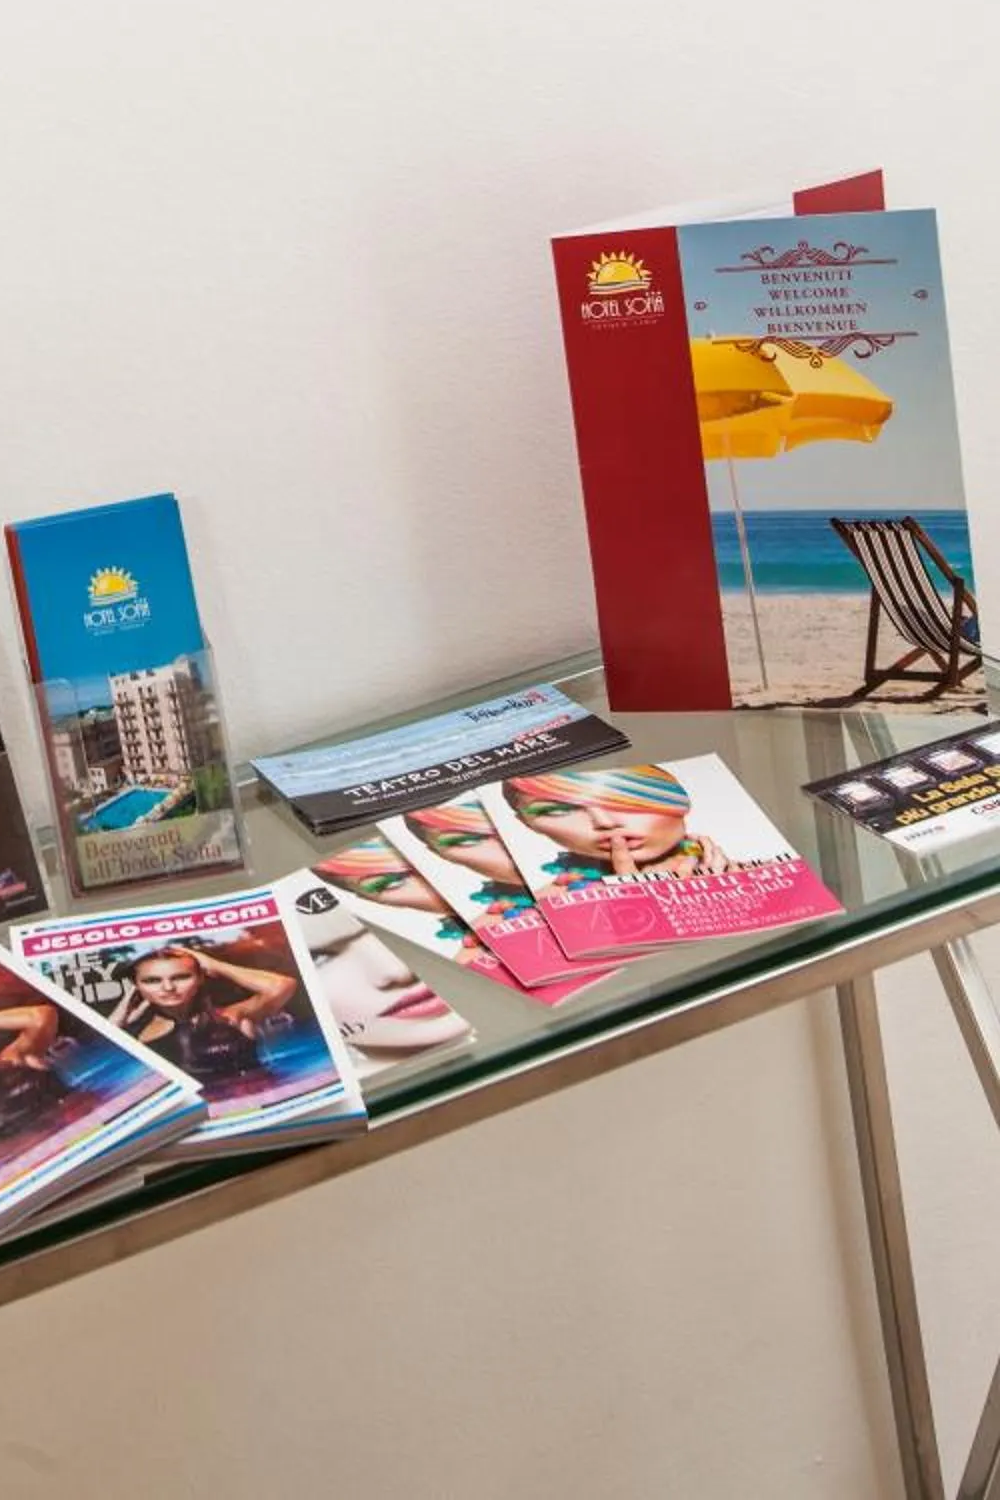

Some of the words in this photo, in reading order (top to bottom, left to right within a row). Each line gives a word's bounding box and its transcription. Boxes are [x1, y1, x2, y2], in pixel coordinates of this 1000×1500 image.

[760, 270, 852, 285] BENVENUTI
[768, 287, 850, 301] WELCOME
[753, 303, 868, 318] WILLKOMMEN
[767, 320, 858, 334] BIENVENUE
[344, 768, 442, 800] TEATRO
[445, 753, 492, 773] DEL
[85, 828, 182, 861] Benvenuti
